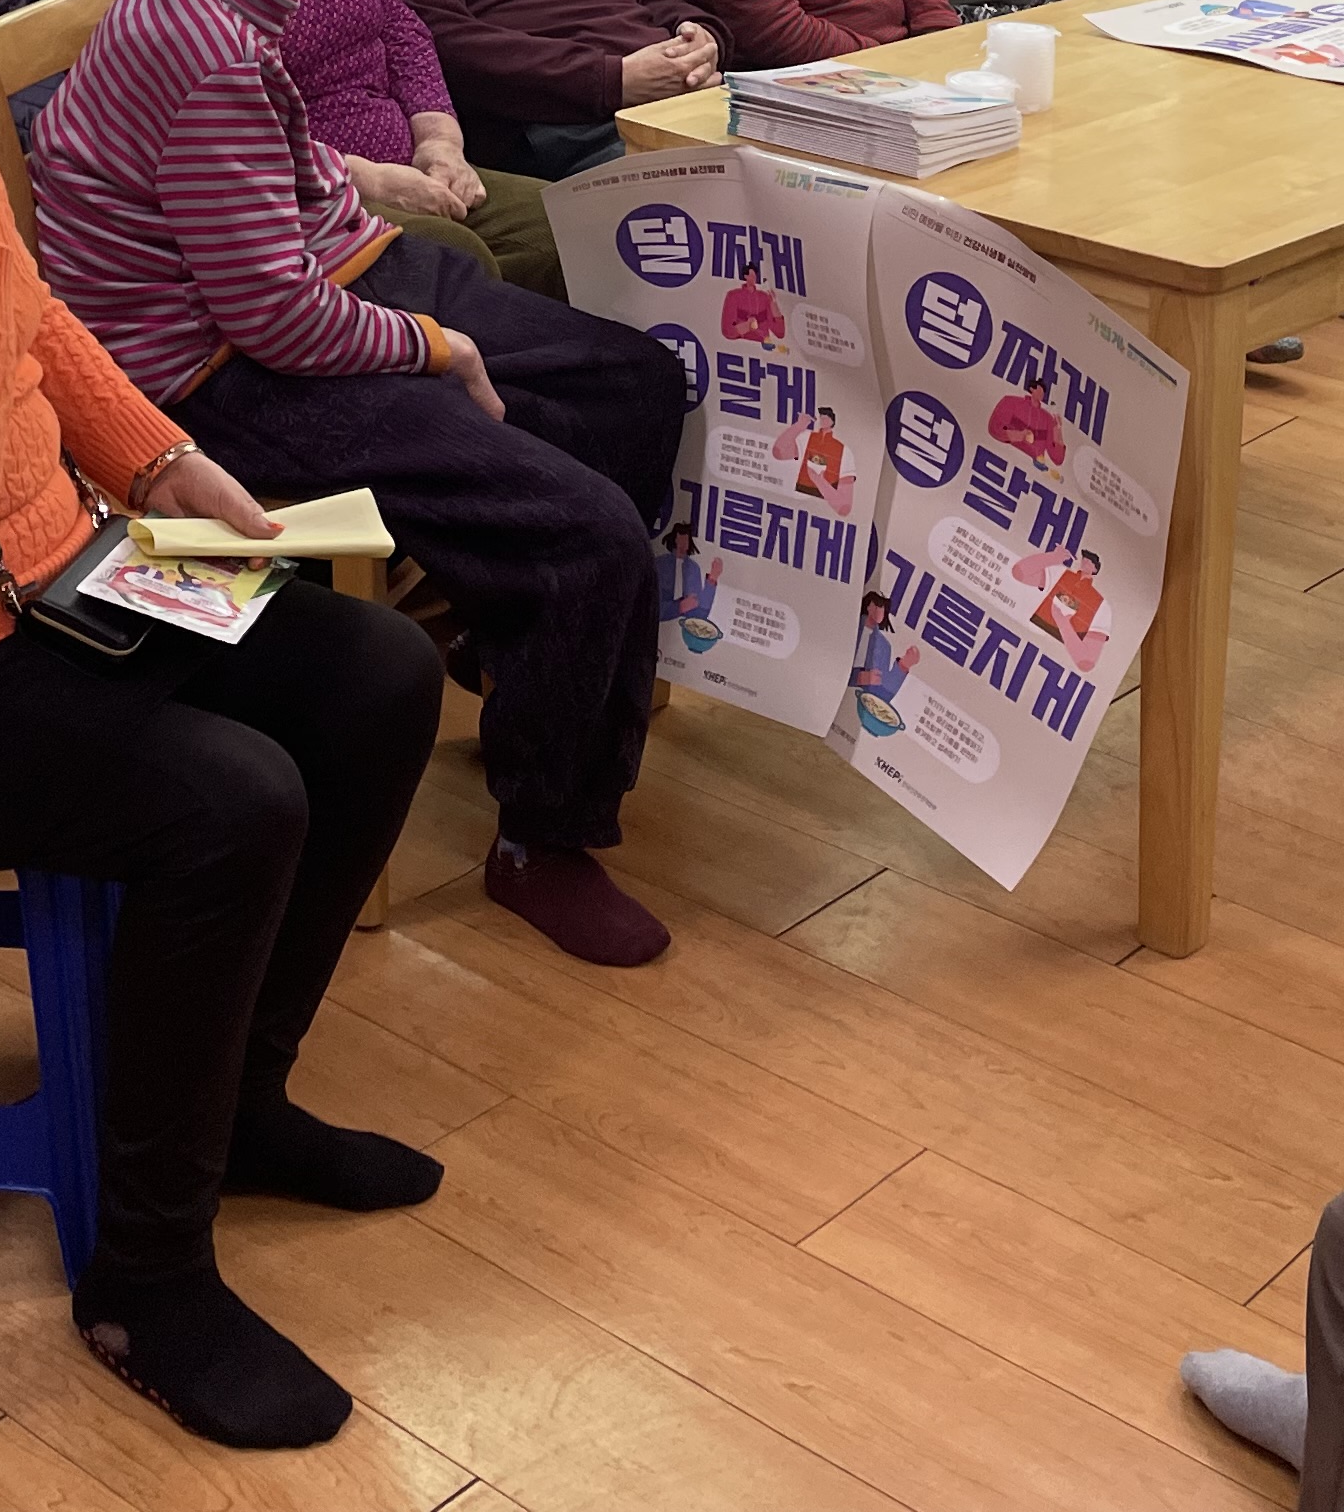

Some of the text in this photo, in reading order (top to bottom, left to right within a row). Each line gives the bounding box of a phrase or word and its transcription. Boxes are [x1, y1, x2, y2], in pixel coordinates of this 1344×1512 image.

[628, 216, 807, 297] 덜 짜게
[717, 351, 816, 430] 달게
[918, 280, 1109, 446] 덜 짜게
[679, 479, 857, 584] 기름지게
[895, 397, 955, 482] 덜
[962, 445, 1089, 568] 달게
[886, 549, 1096, 741] 기름지게
